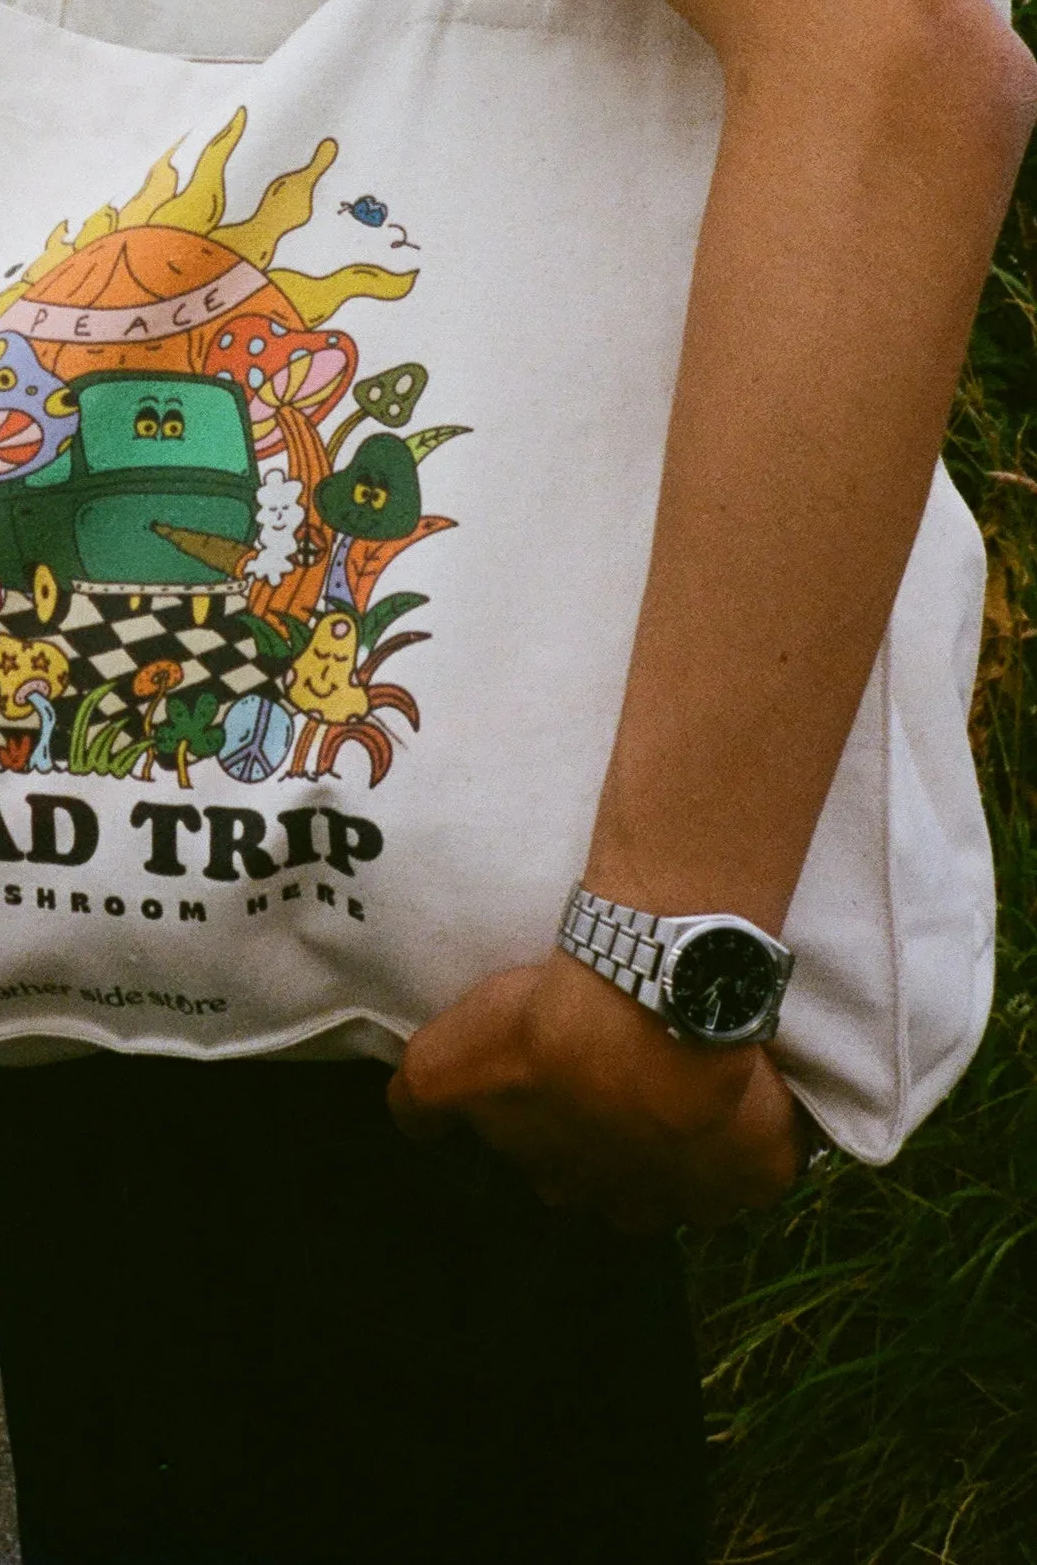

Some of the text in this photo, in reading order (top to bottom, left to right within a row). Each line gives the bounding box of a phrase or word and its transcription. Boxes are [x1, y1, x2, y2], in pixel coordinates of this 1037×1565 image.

[30, 287, 225, 337] PEACE
[130, 801, 384, 882] TRIP
[246, 881, 366, 922] HERE
